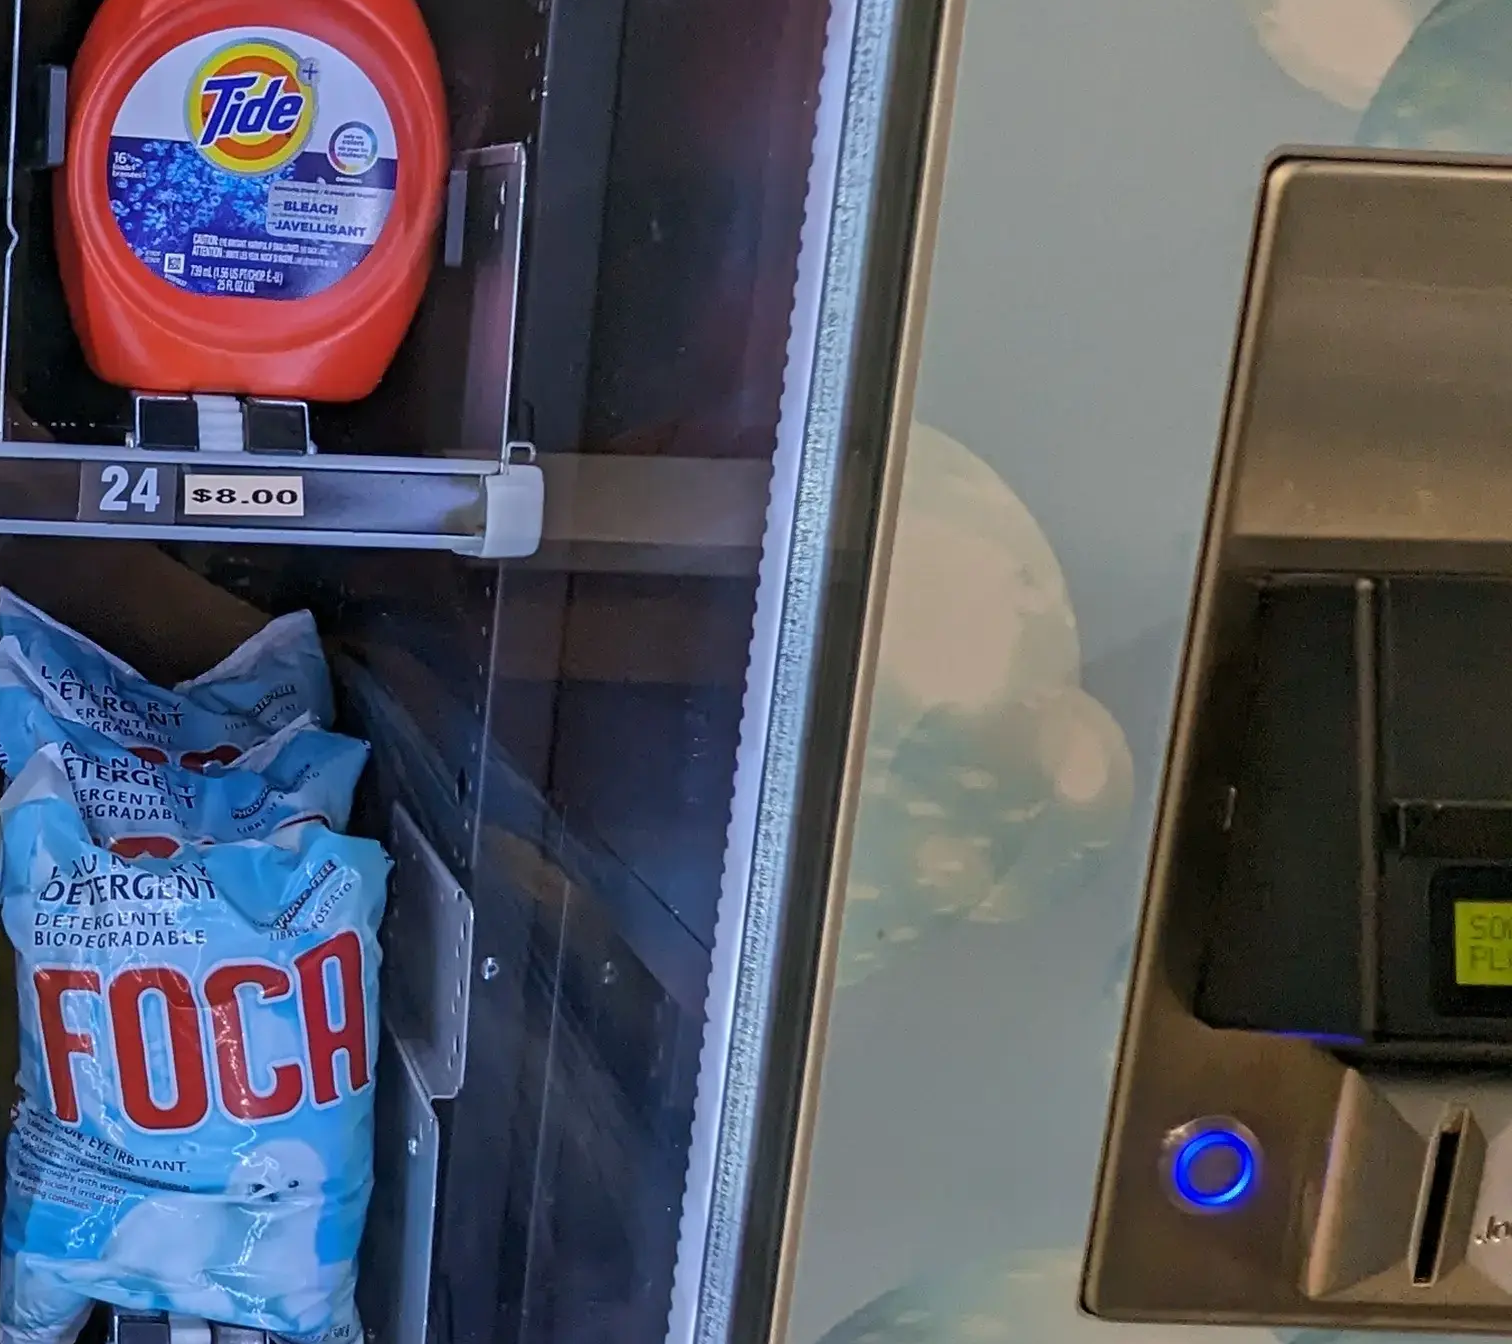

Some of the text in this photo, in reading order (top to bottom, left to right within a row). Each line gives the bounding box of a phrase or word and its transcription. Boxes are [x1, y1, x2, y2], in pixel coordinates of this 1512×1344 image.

[198, 73, 304, 147] Tide
[114, 152, 127, 164] 16
[283, 201, 339, 215] BLEACH
[275, 220, 367, 237] JAVELLISANT
[99, 466, 160, 512] 24
[192, 488, 298, 504] $8.00
[40, 873, 216, 905] DETERGENT
[311, 882, 352, 929] FOSFATO
[35, 913, 175, 930] DETERGENTE
[35, 929, 207, 948] BIODEGRADABLE
[32, 930, 370, 1132] FOCA
[88, 1137, 111, 1156] EYE
[113, 1148, 191, 1173] IRRITANT.
